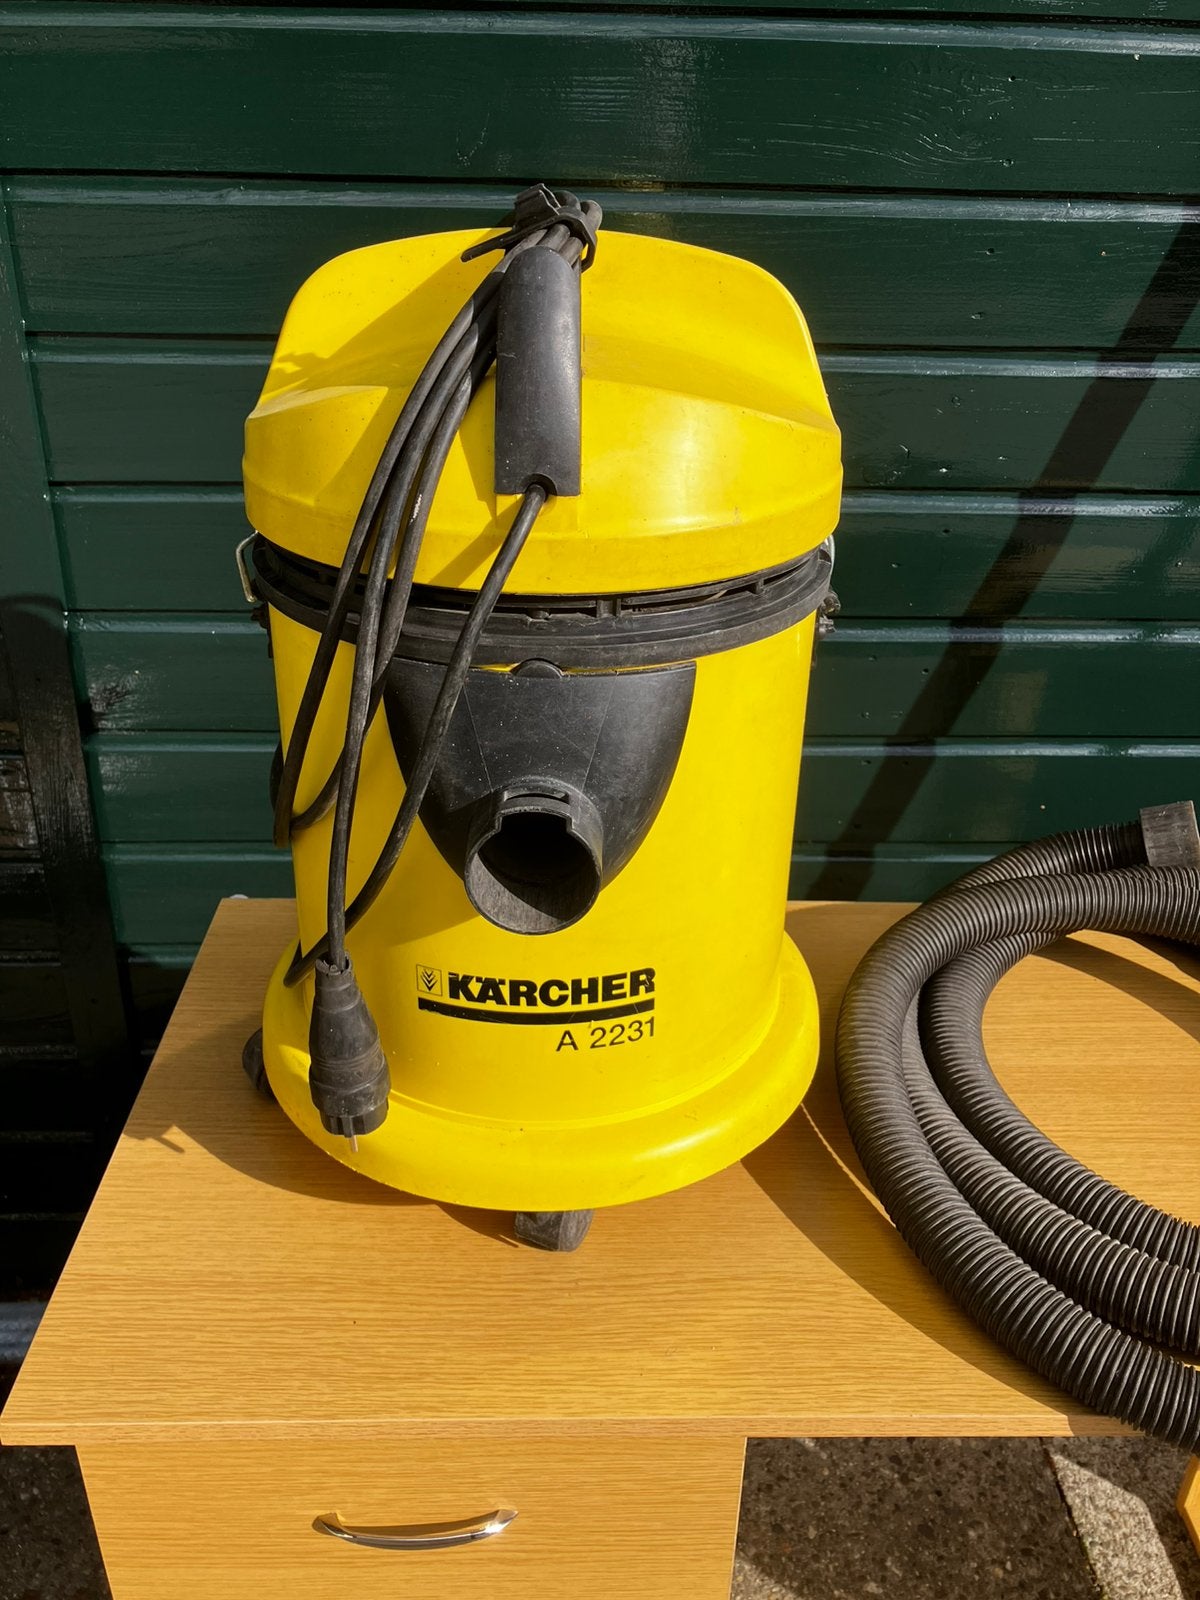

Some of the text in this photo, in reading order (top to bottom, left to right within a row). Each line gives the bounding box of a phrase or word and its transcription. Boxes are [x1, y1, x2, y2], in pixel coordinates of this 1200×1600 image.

[448, 967, 656, 1007] KÄRCHER
[556, 1016, 655, 1052] A 2231
